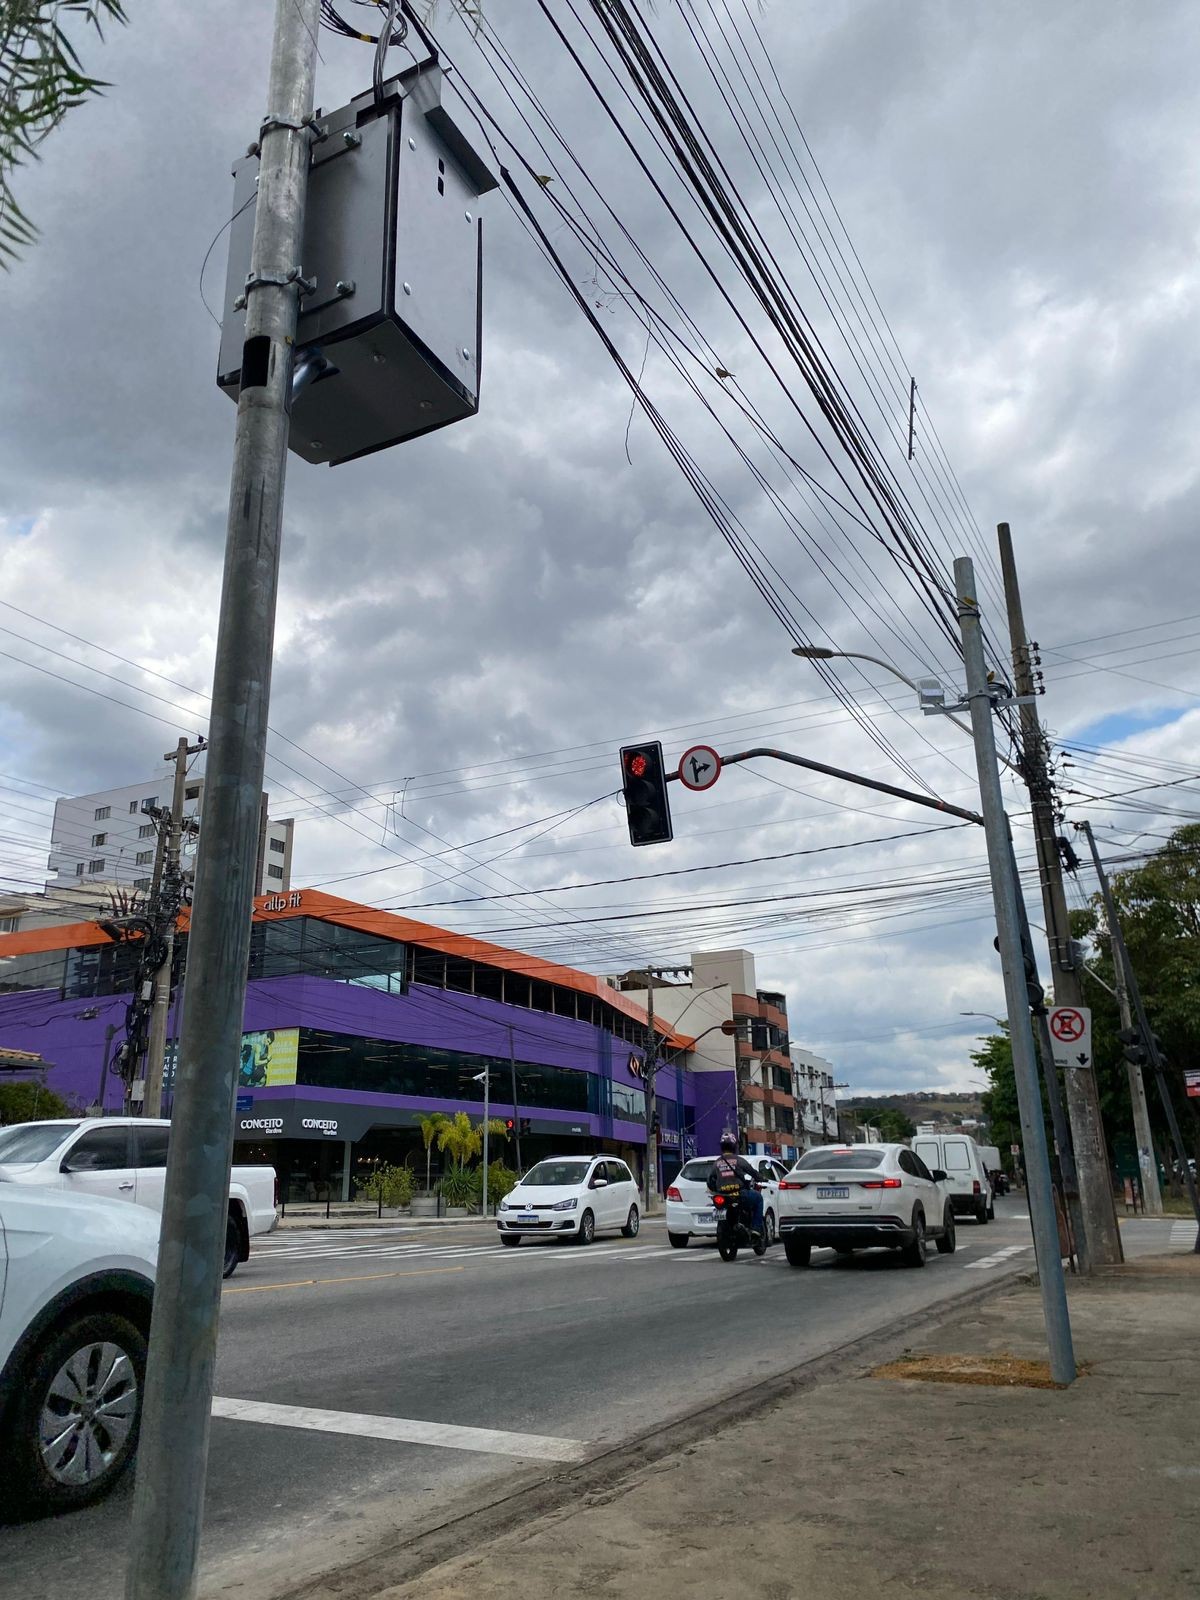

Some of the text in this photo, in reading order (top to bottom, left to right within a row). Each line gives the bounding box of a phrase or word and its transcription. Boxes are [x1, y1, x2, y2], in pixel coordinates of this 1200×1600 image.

[263, 892, 302, 912] allp fit
[240, 1118, 284, 1129] CONCEITO
[302, 1118, 338, 1130] CONCEITO
